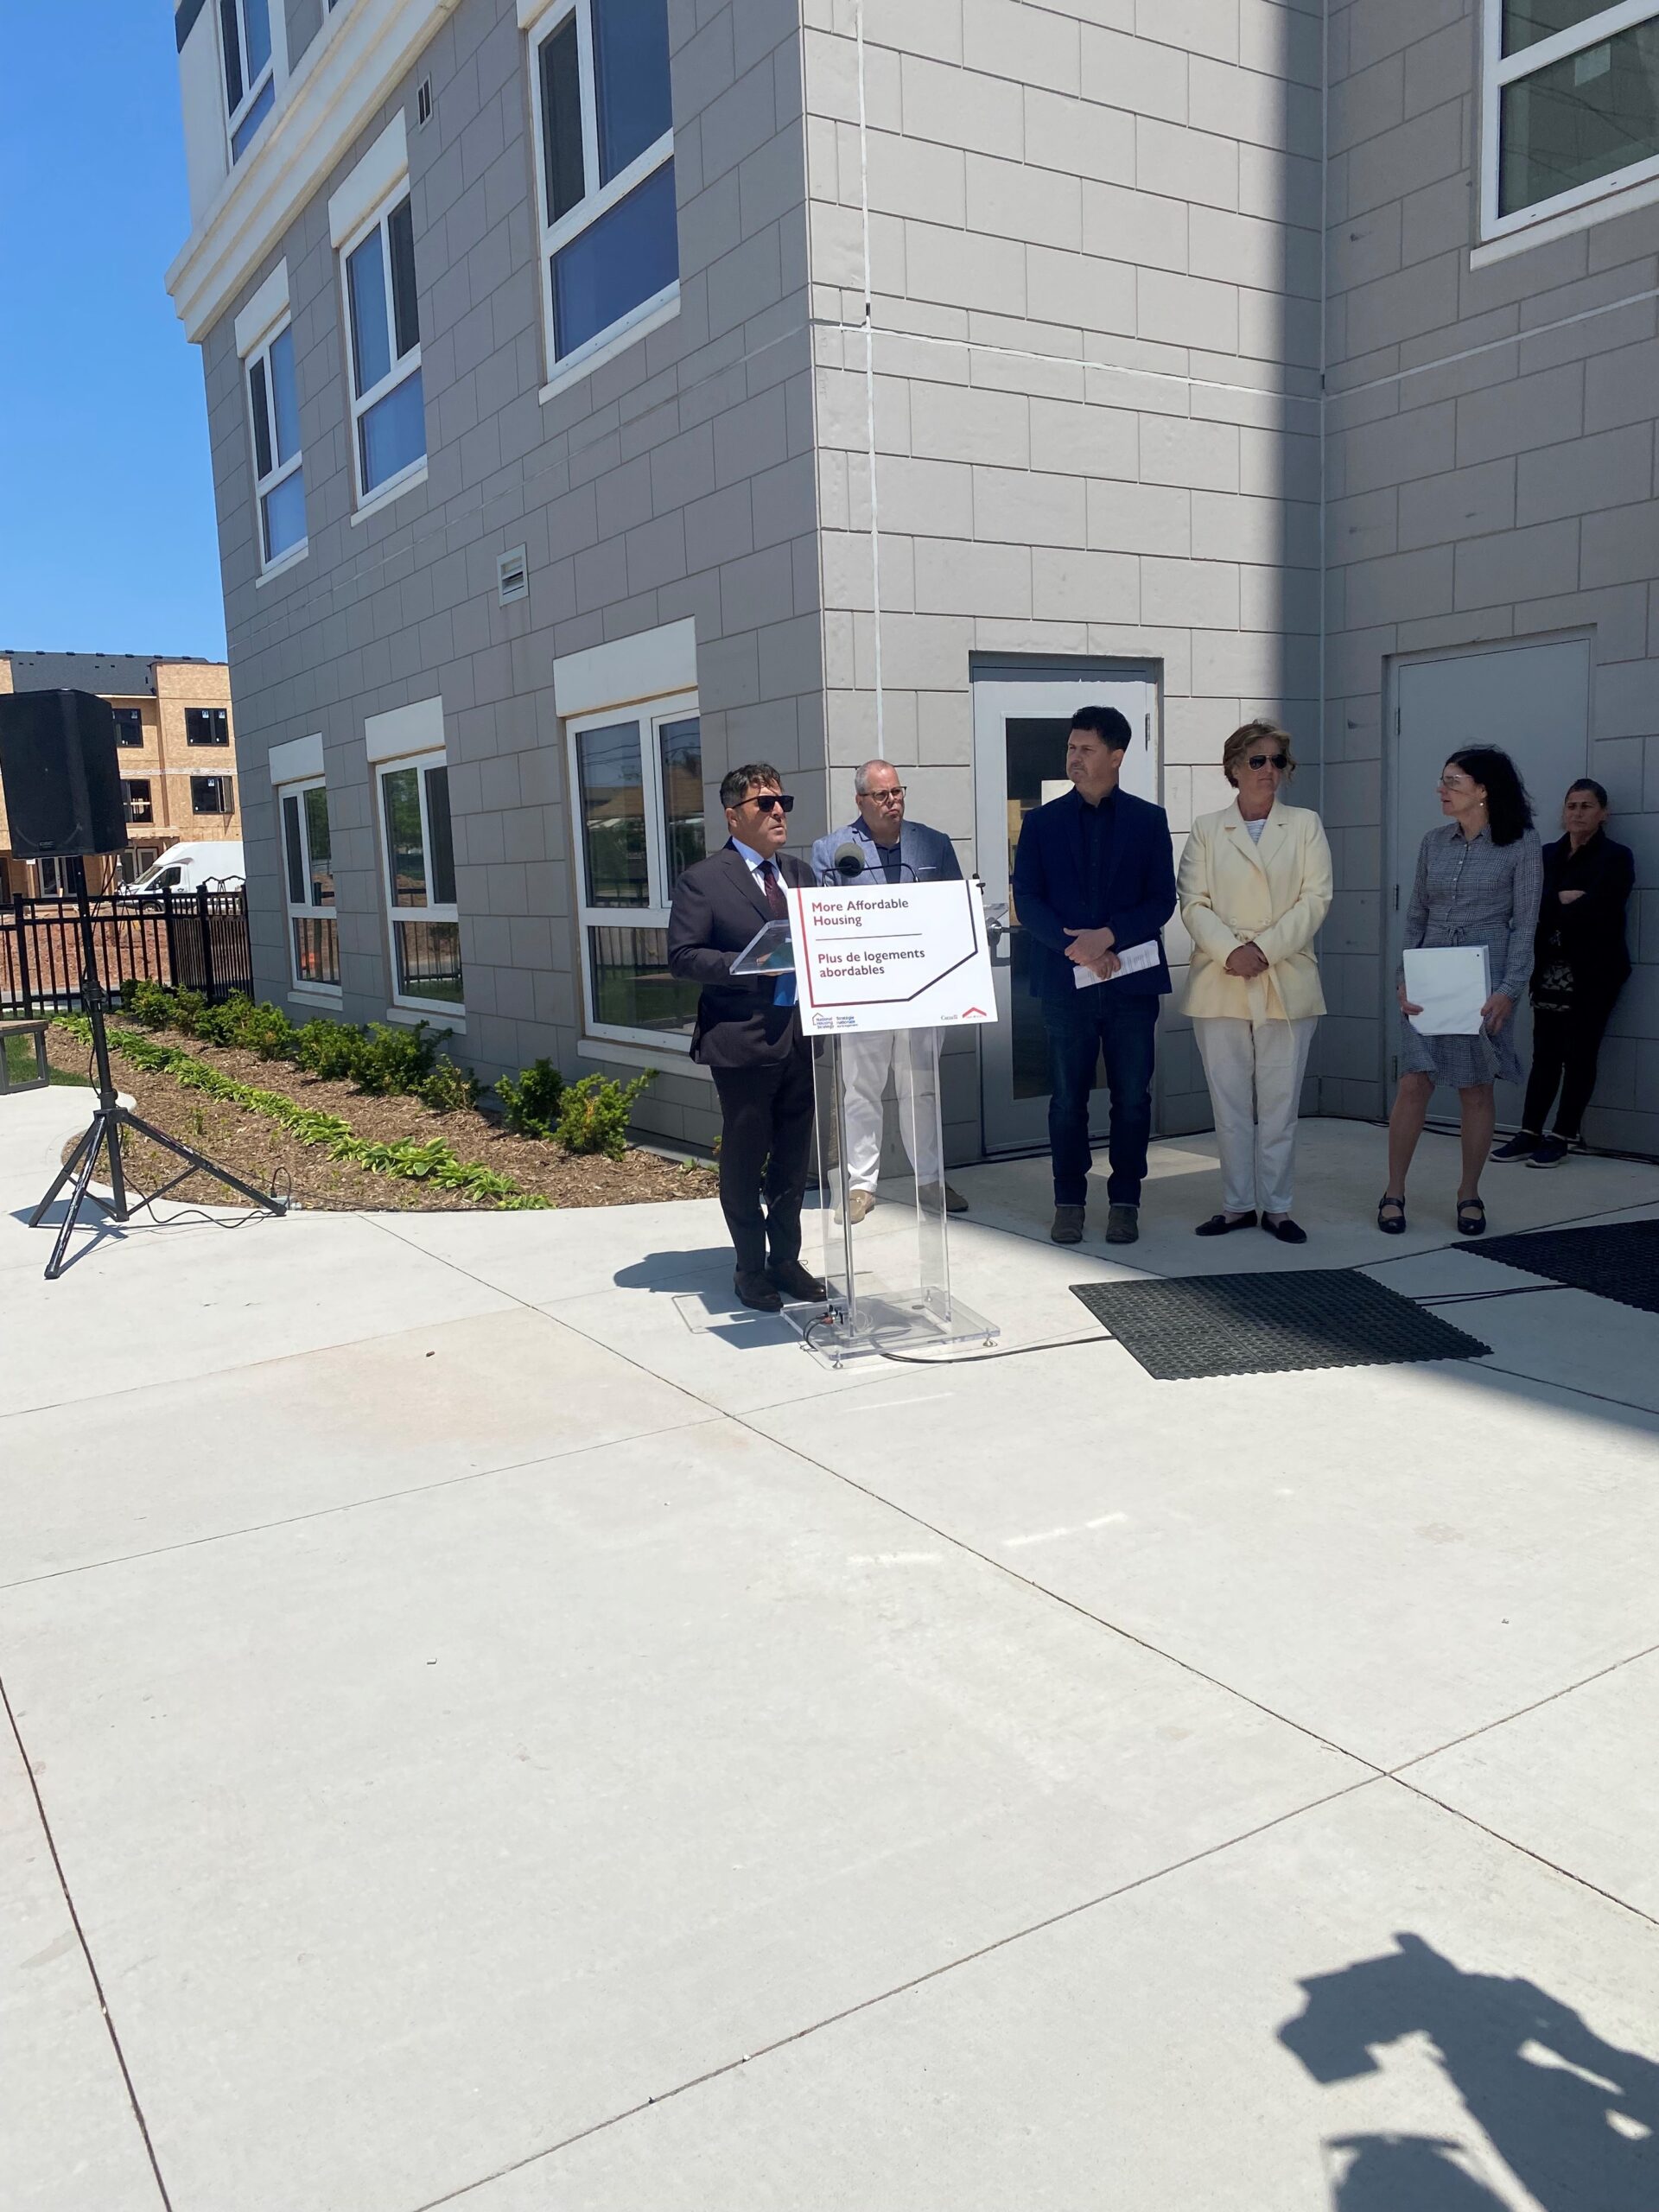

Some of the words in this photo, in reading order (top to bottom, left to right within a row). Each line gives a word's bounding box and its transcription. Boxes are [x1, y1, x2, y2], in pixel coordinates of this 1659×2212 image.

[812, 902, 843, 912] More
[847, 899, 909, 911] Affordable
[813, 915, 862, 927] Housing
[818, 953, 842, 963] Plus
[846, 952, 861, 962] de
[864, 950, 925, 963] logements
[820, 965, 885, 977] abordables
